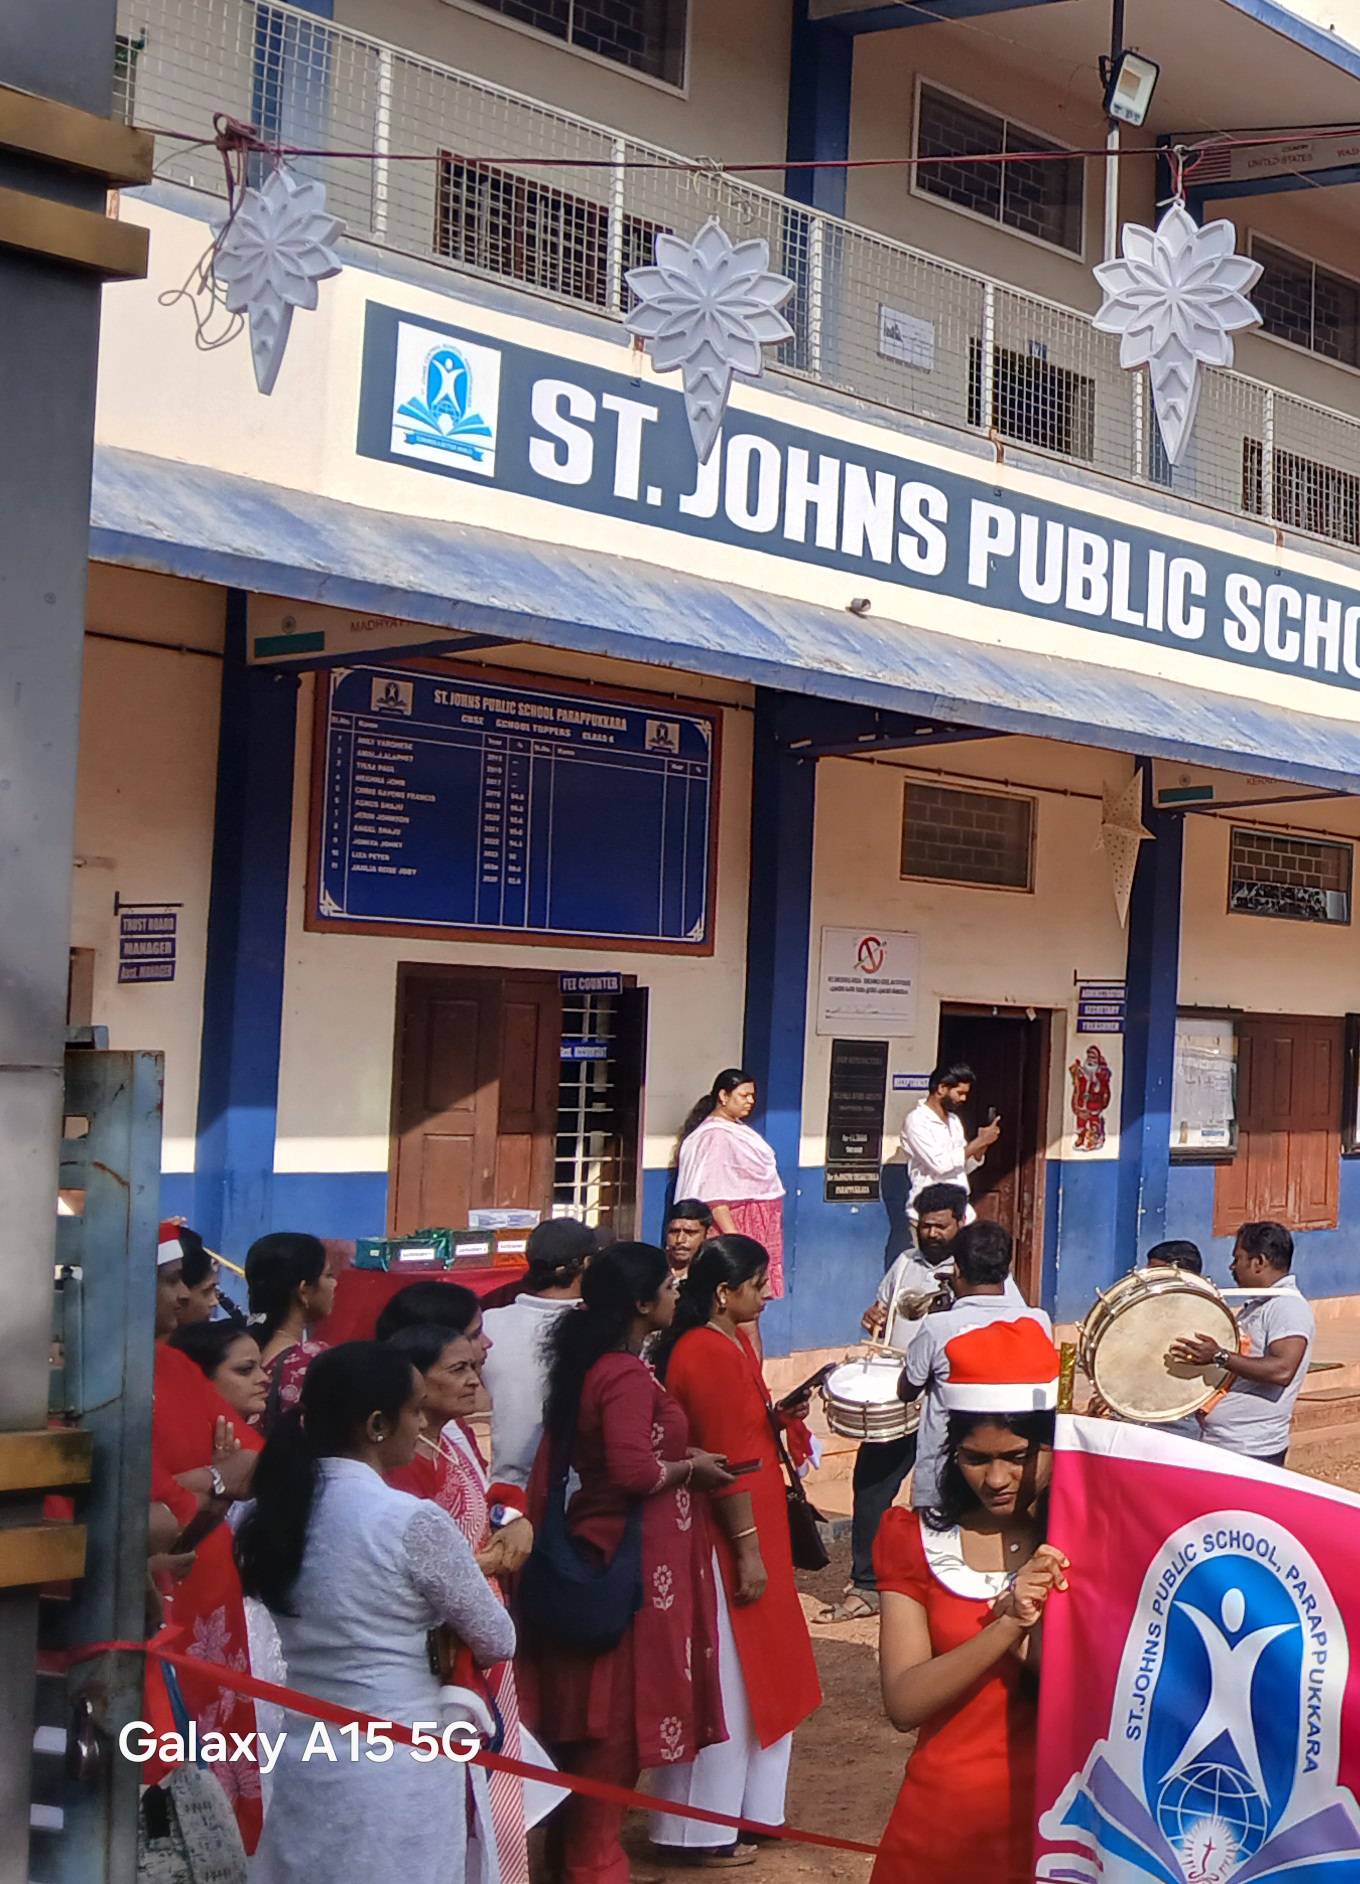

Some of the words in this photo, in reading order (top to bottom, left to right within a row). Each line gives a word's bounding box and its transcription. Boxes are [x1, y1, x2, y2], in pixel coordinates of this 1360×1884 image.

[529, 378, 661, 507] ST.
[679, 426, 947, 577] JOHNS
[967, 497, 1206, 641] PUBLIC
[351, 619, 398, 632] MADHYA
[434, 689, 448, 704] ST.
[450, 691, 480, 709] JOHNS
[482, 697, 516, 716] PUBLIC
[518, 702, 554, 721] SCHOOL
[556, 708, 627, 731] PARAPPUKKARA
[123, 918, 147, 932] TRUST
[123, 941, 172, 954] MANAGER
[563, 977, 577, 990] FEE
[578, 976, 618, 989] COUNTER
[1152, 1542, 1197, 1615] PUBLIC
[1203, 1530, 1282, 1572] SCHOOL,
[1286, 1564, 1329, 1774] PARAPPUKKARA
